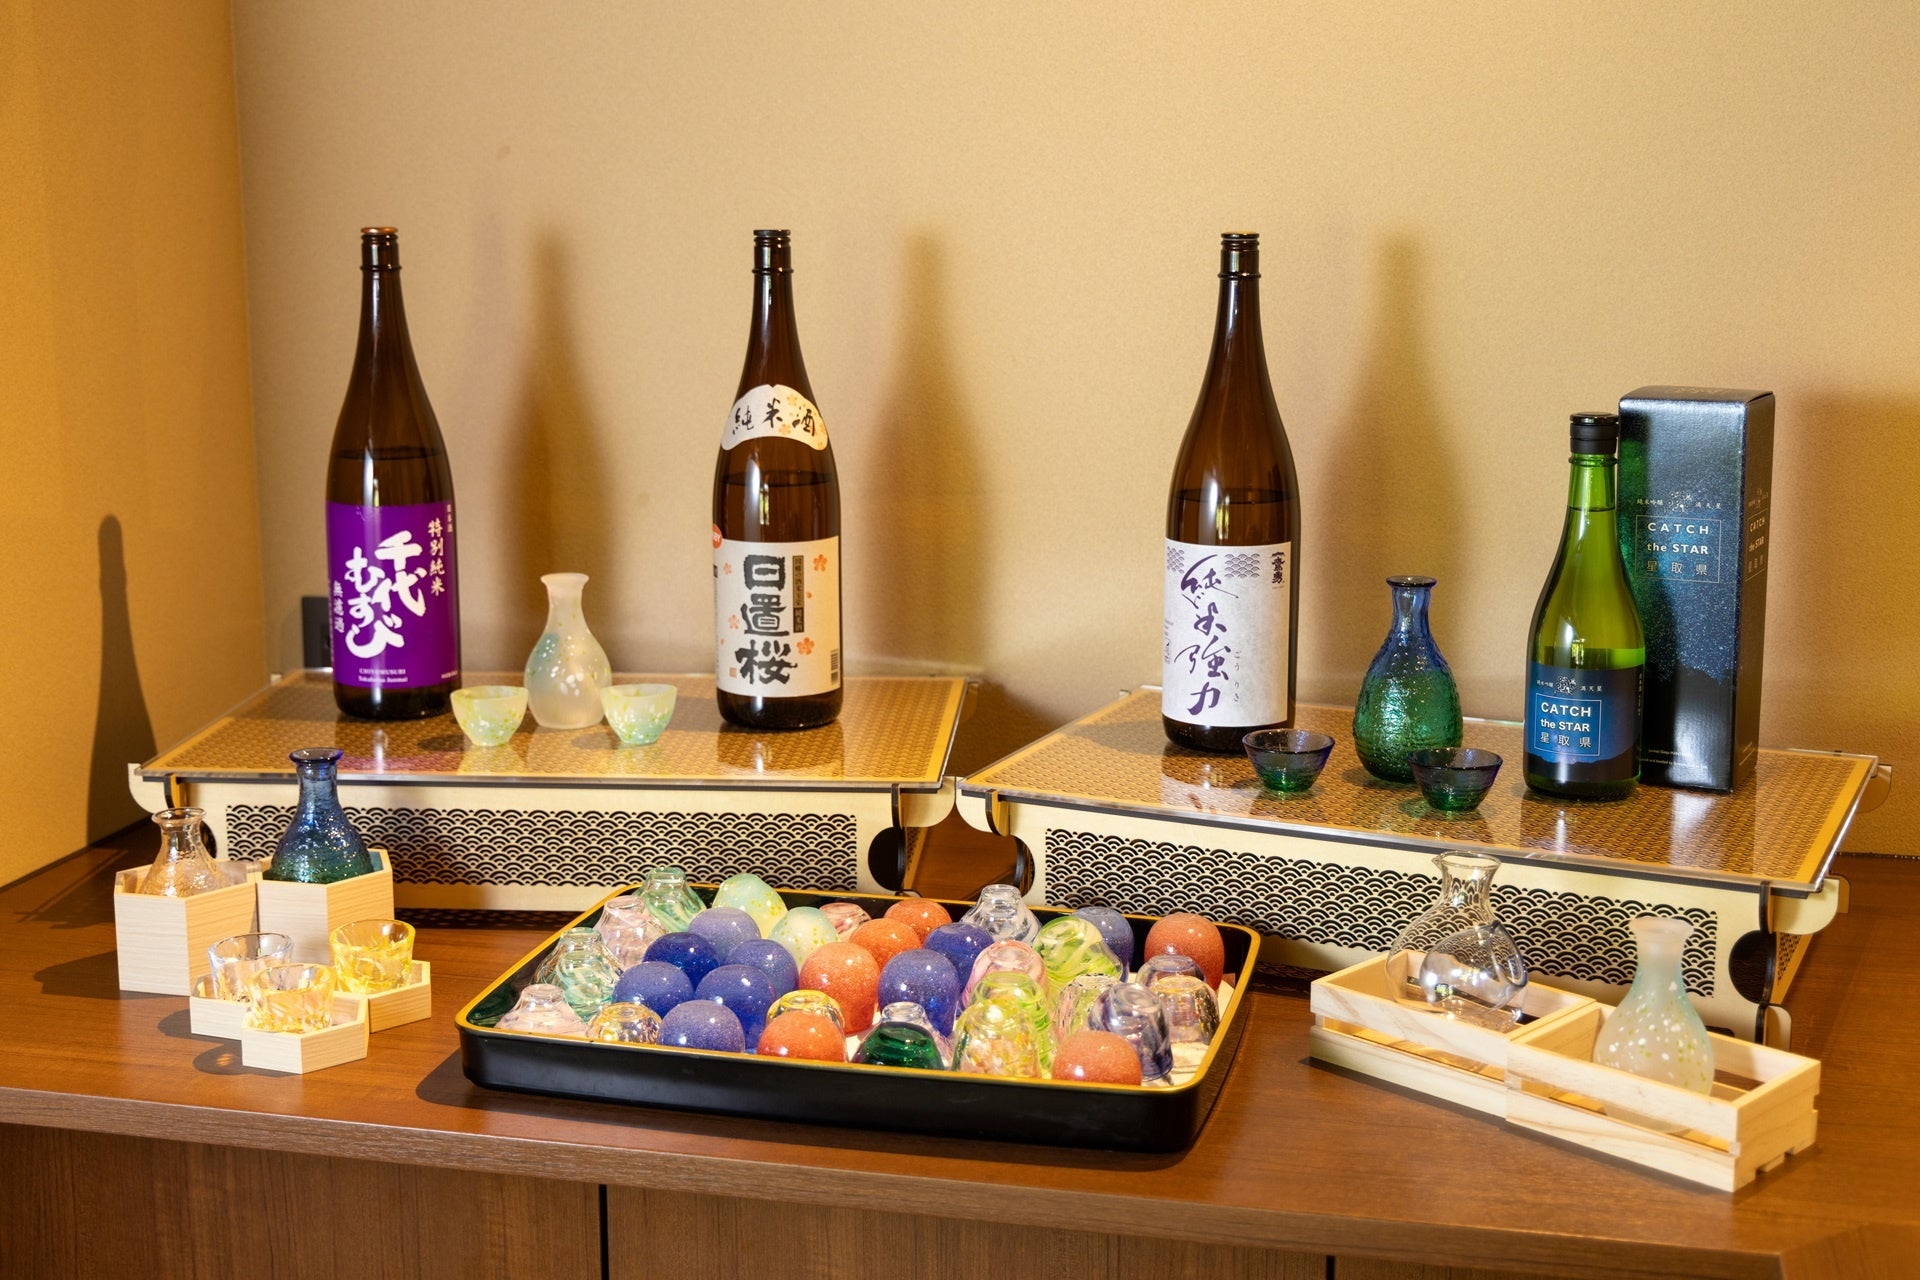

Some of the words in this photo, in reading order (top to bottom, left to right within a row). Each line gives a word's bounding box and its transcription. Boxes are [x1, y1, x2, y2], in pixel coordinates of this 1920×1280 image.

[732, 397, 815, 436] 純米酒
[1648, 522, 1709, 535] CATCH
[427, 517, 445, 597] 特別純米
[1647, 543, 1667, 552] the
[1672, 543, 1709, 555] STAR
[372, 530, 427, 617] 千代
[1647, 560, 1707, 576] 星取県
[344, 546, 404, 659] むすび
[735, 554, 798, 685] 日置桜
[1174, 554, 1239, 716] 純米強力
[1540, 702, 1591, 718] CATCH
[1540, 718, 1556, 729] the
[1558, 721, 1590, 732] STAR
[1540, 732, 1592, 748] 星取県
